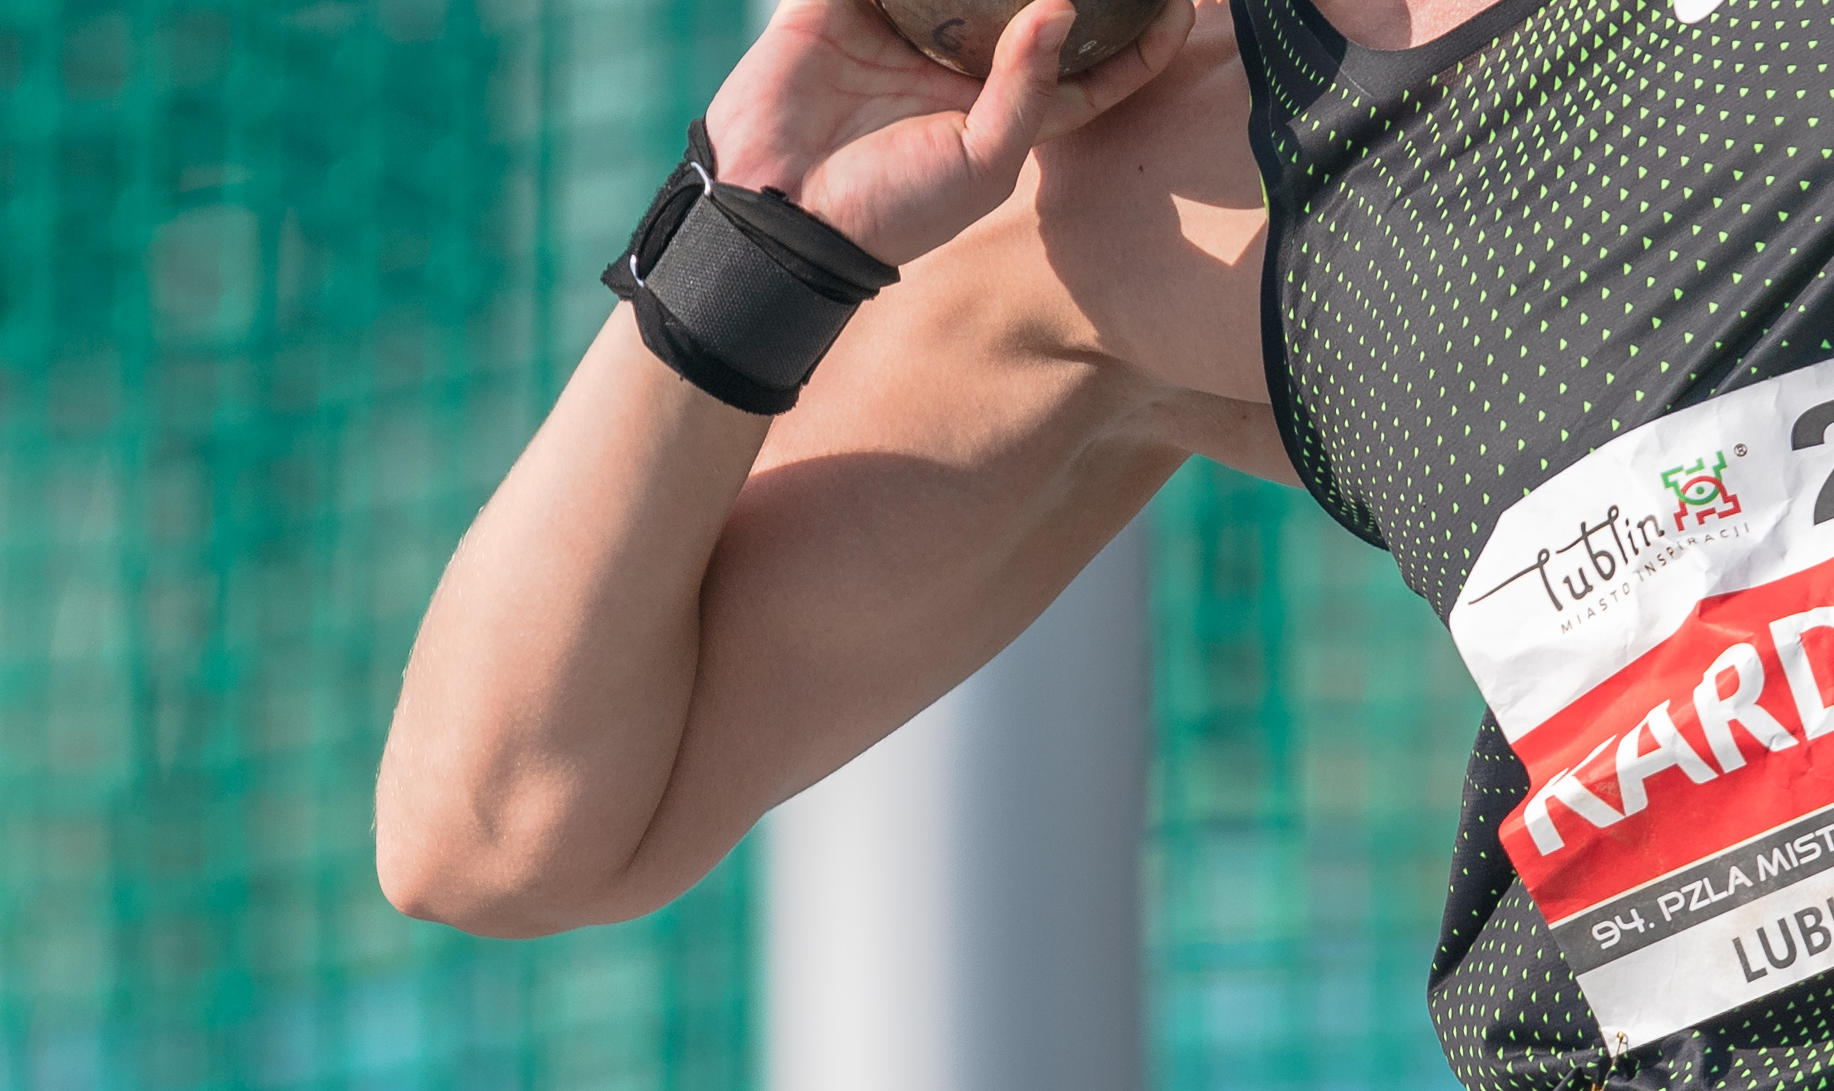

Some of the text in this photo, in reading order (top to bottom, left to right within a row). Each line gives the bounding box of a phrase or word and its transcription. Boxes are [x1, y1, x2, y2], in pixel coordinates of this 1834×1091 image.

[1560, 521, 1751, 635] MIASTO INSPIRACJI
[1591, 908, 1656, 950] 94.
[1656, 865, 1754, 922] PZLA
